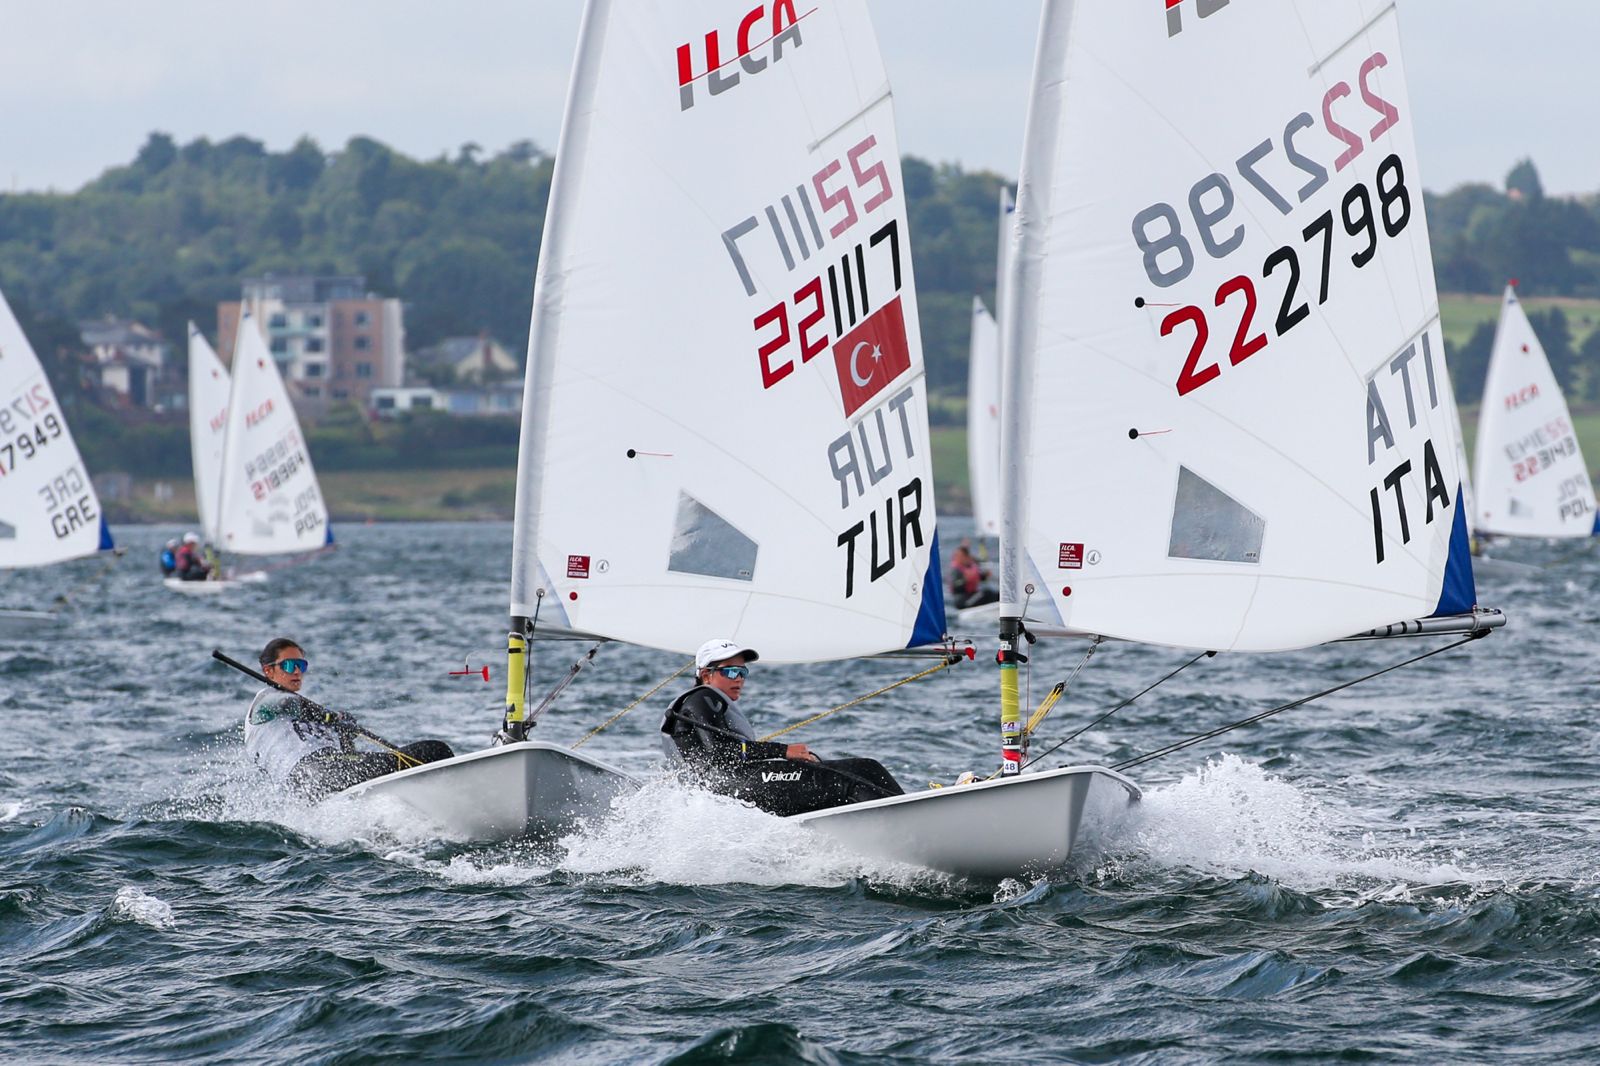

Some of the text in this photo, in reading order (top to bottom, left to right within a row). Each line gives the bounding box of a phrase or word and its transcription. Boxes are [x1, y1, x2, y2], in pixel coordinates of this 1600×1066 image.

[676, 0, 803, 112] ILCA
[753, 218, 901, 390] 221117
[1160, 153, 1411, 397] 222798
[51, 495, 97, 540] GRE
[837, 477, 924, 599] TUR
[1370, 438, 1451, 565] ITA
[761, 770, 803, 783] Vaikobi
[1005, 762, 1016, 771] 48
